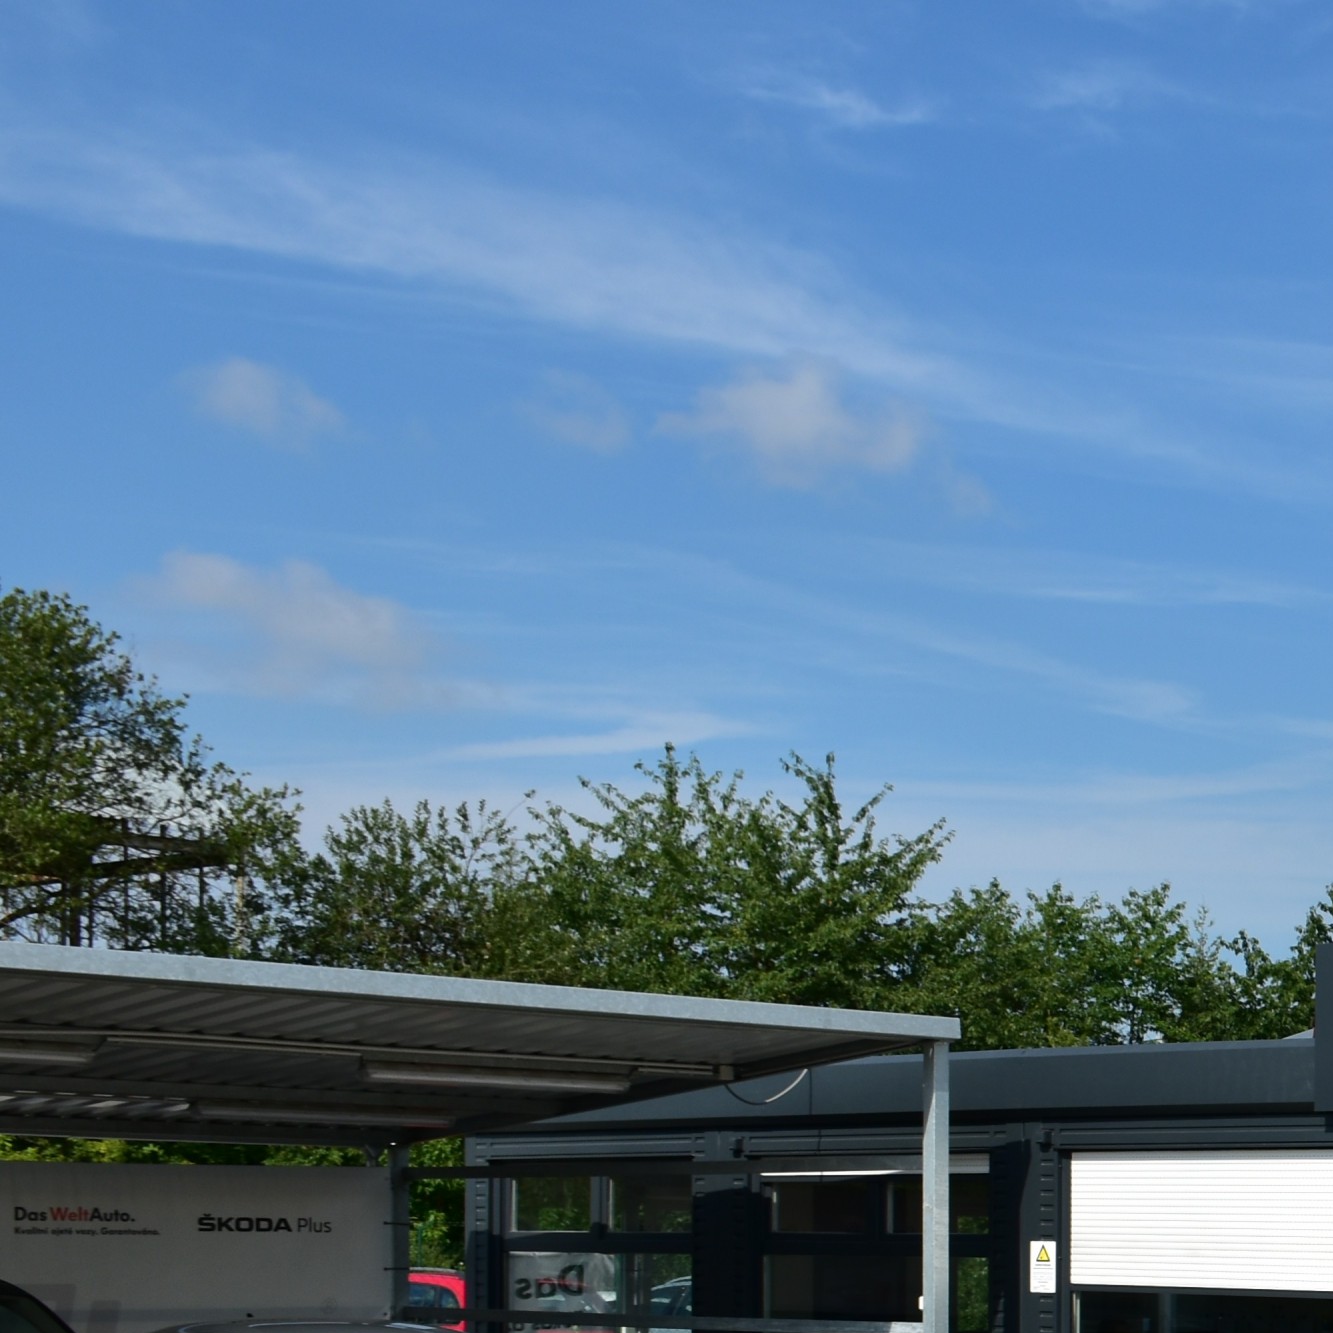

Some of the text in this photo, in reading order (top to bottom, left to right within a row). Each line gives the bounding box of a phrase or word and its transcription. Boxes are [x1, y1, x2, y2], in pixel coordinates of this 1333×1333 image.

[14, 1206, 48, 1222] Das
[197, 1213, 332, 1232] ŠKODA Plus
